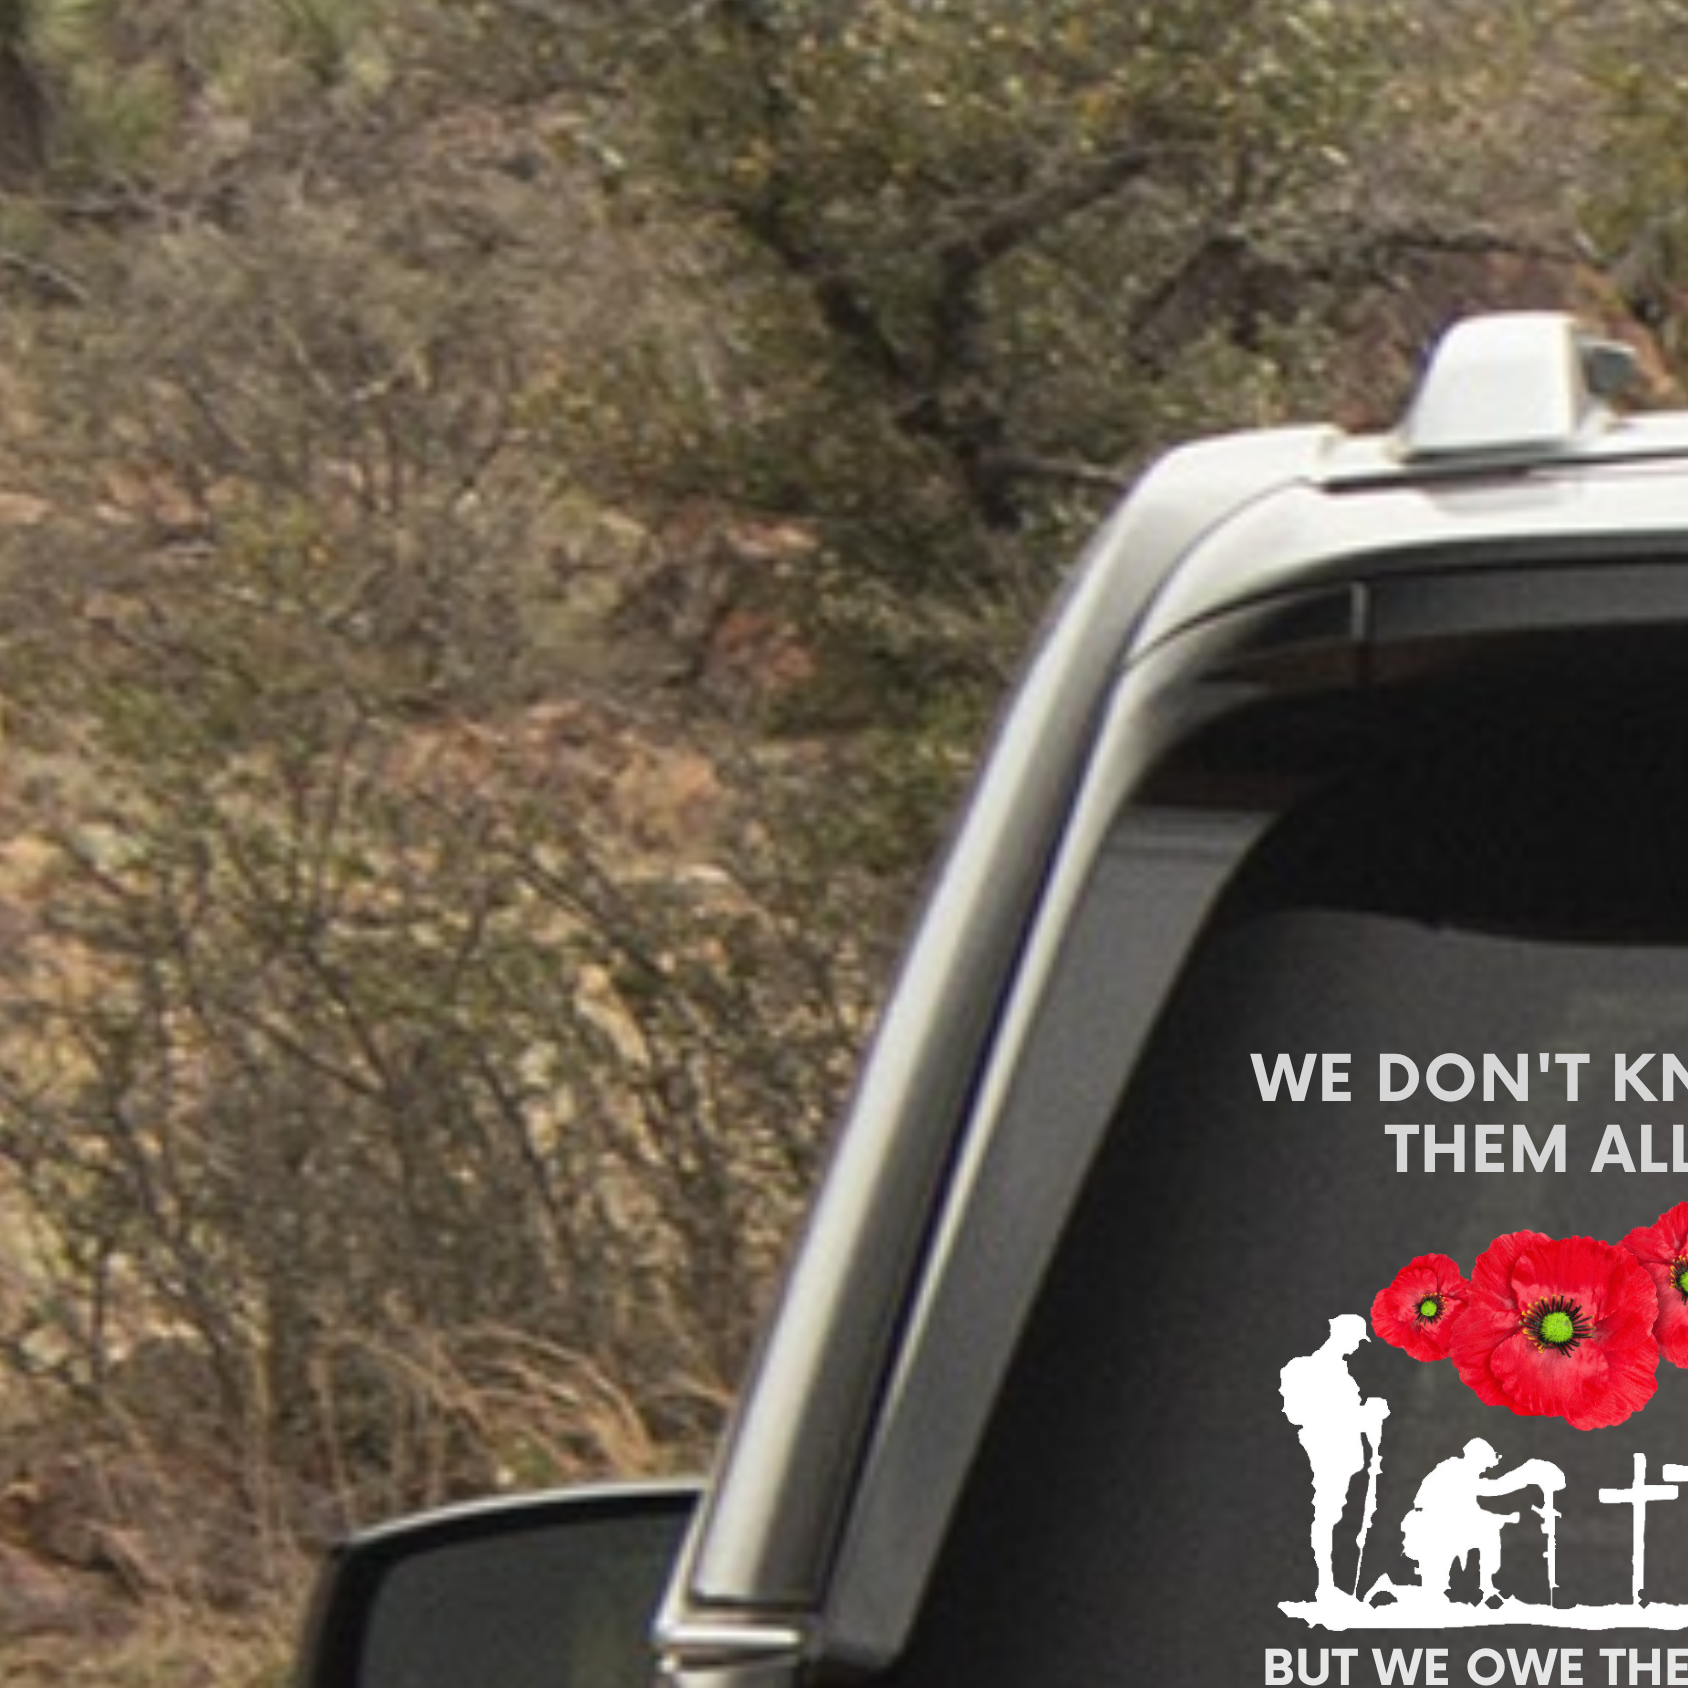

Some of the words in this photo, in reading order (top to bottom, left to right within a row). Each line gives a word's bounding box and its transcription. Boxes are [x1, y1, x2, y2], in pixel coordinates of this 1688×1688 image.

[1249, 1053, 1353, 1102] WE
[1379, 1052, 1591, 1103] DON'T
[1384, 1124, 1567, 1173] THEM
[1264, 1648, 1359, 1687] BUT
[1371, 1648, 1449, 1686] WE
[1466, 1647, 1584, 1687] OWE
